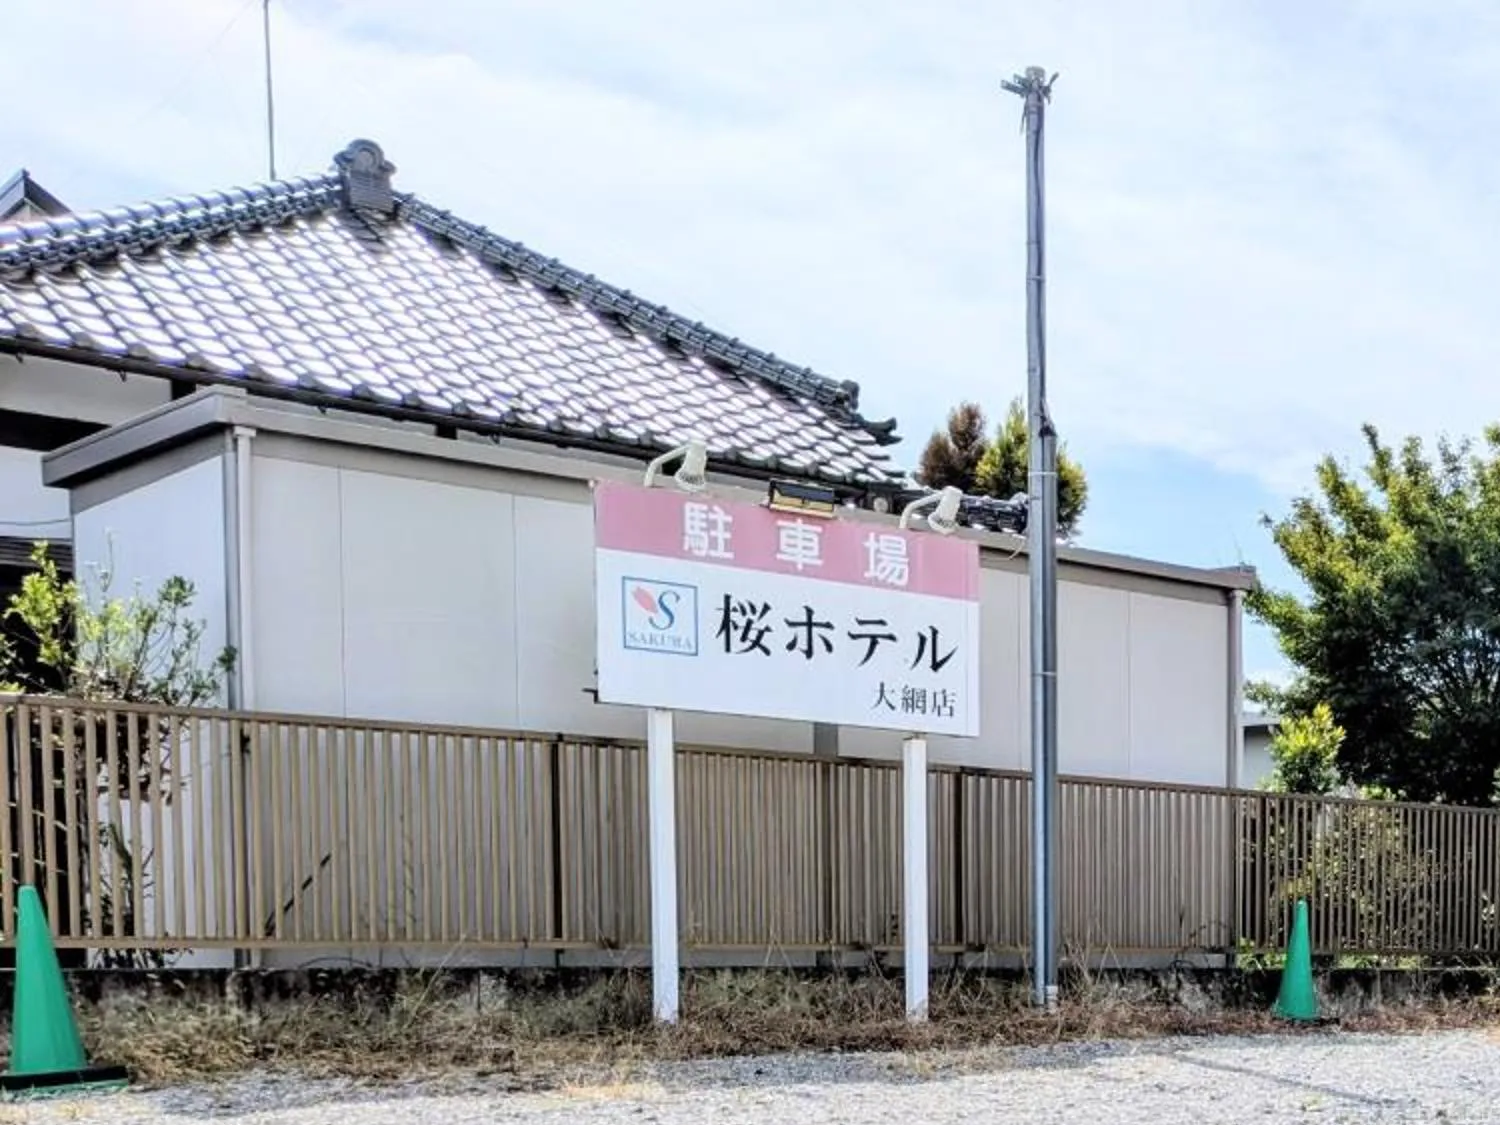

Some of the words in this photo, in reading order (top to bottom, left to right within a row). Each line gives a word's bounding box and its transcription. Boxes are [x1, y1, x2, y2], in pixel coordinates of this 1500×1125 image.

[682, 501, 909, 586] 駐車場
[648, 590, 680, 631] S
[715, 594, 959, 674] 桜ホテル
[871, 681, 957, 718] 大網店
